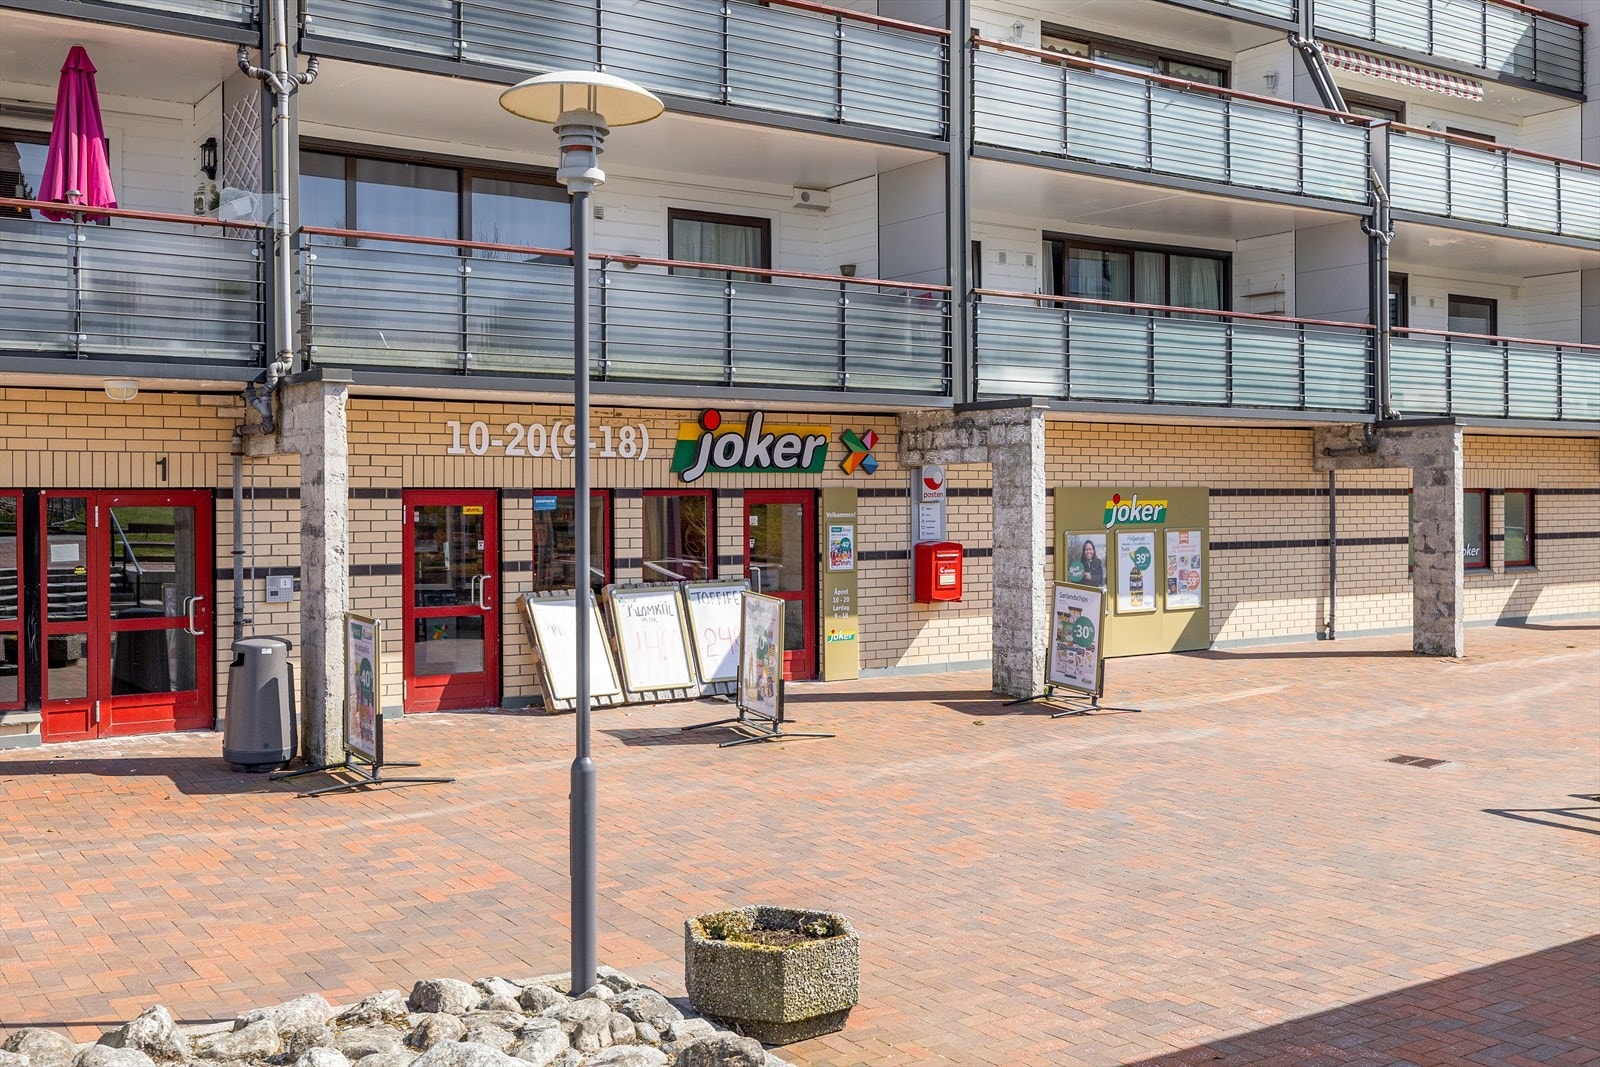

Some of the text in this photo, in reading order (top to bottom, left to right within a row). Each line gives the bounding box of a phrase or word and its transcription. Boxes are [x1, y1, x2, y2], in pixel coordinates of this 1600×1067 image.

[680, 408, 827, 483] joker
[156, 456, 167, 482] 1
[923, 491, 944, 499] posten
[1105, 492, 1164, 529] joker
[828, 629, 853, 643] joker
